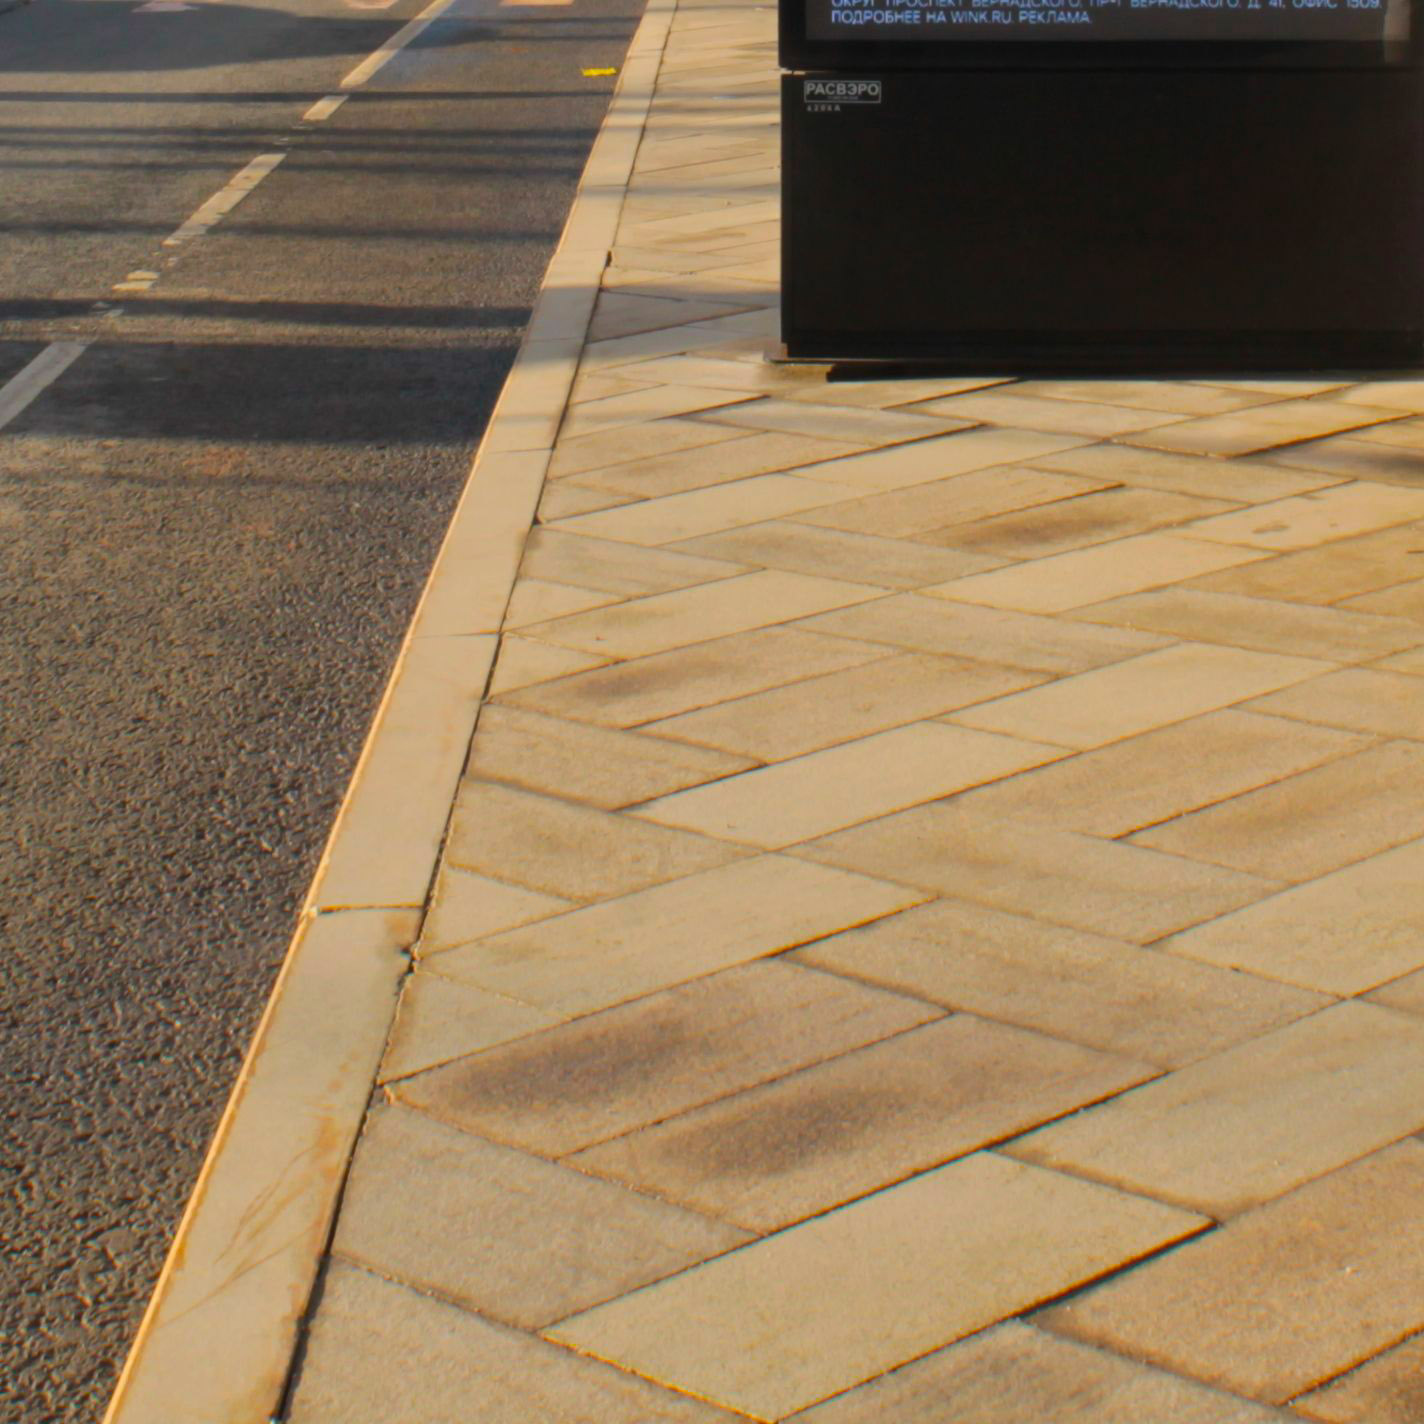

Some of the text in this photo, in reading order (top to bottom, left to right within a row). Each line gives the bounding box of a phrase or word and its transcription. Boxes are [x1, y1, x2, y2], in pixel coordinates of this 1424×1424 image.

[832, 9, 922, 24] ПОДРОБНЕЕ
[926, 9, 948, 23] НА
[806, 82, 880, 96] РАСВЭРО
